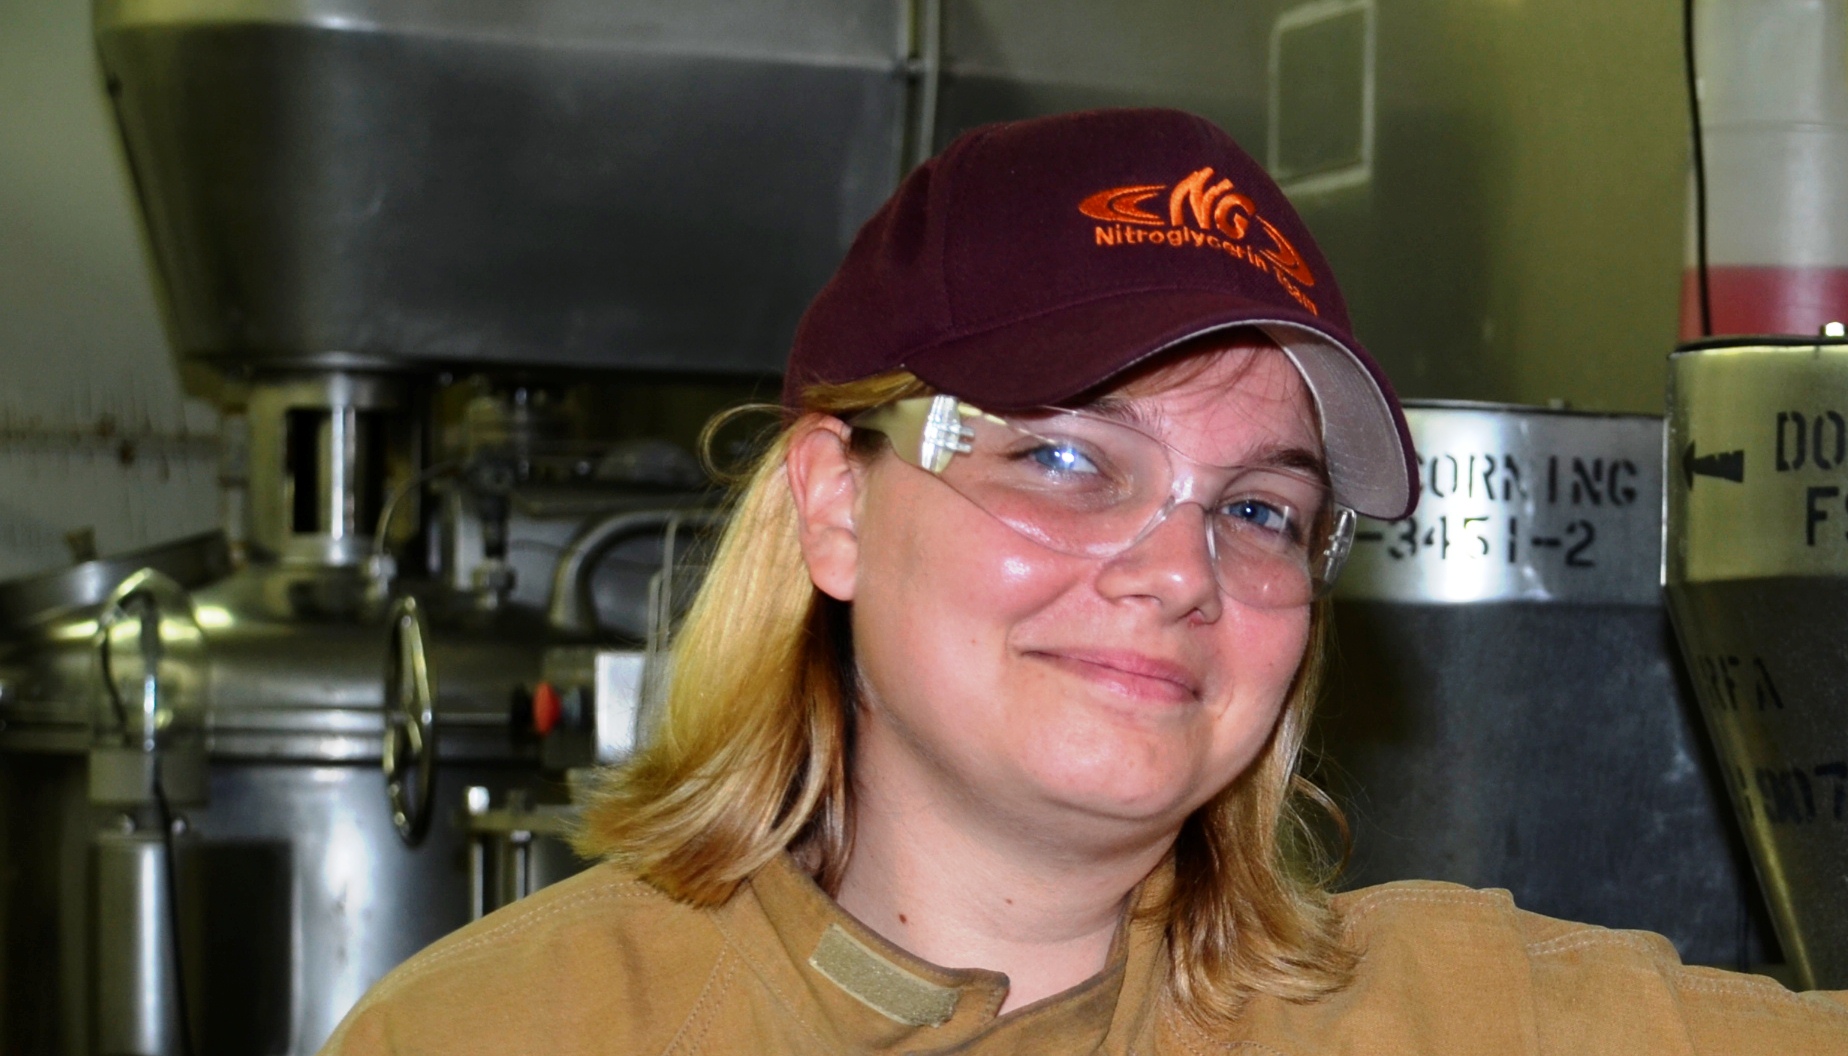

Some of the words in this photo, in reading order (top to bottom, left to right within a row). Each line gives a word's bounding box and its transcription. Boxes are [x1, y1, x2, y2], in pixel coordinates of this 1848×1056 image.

[1169, 167, 1256, 239] NG
[1095, 224, 1269, 272] Nitroglycerin
[1274, 267, 1318, 316] Team
[1419, 454, 1637, 506] ORNING
